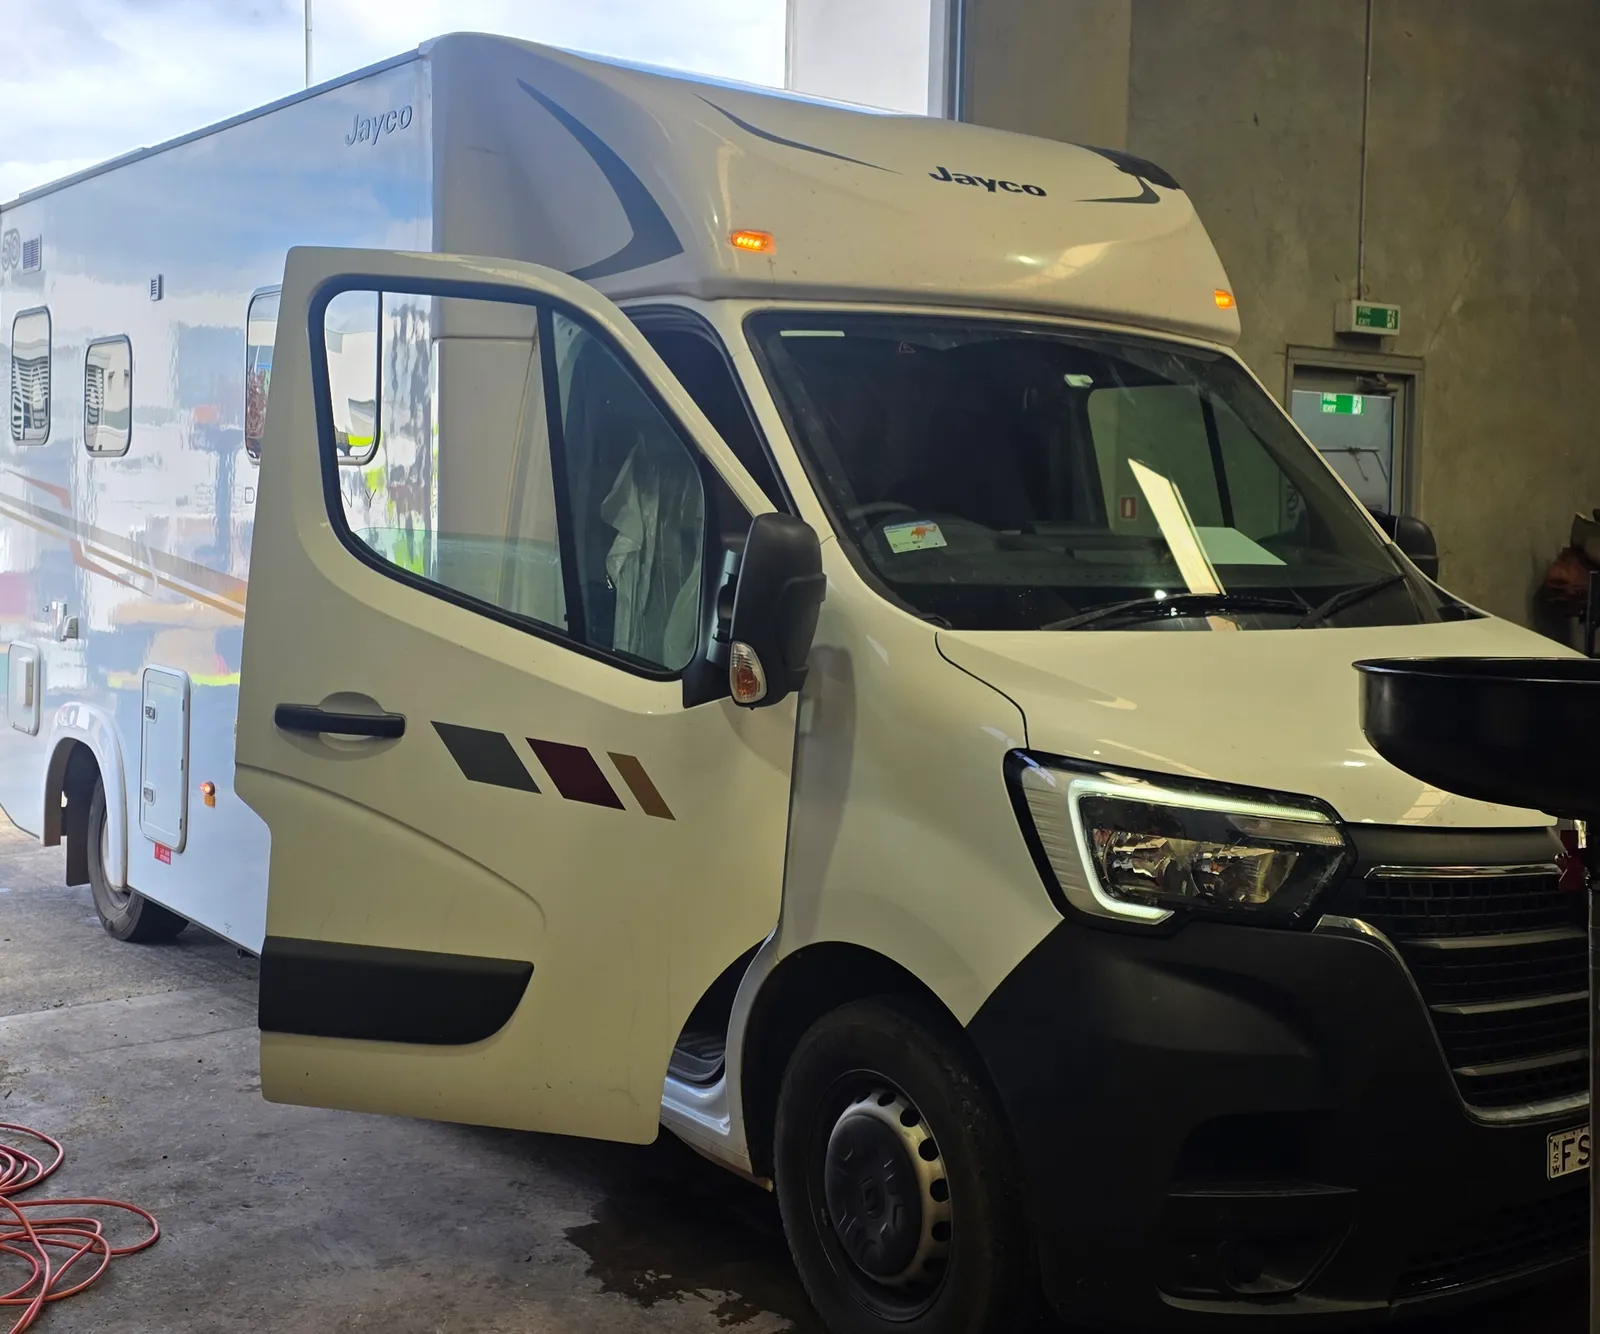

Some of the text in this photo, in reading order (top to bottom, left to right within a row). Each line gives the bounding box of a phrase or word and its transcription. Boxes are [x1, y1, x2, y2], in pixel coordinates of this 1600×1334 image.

[344, 105, 413, 147] Jayco
[928, 165, 1047, 197] Jayco
[1358, 306, 1371, 316] FIRE
[1358, 317, 1371, 327] EXIT
[1323, 392, 1337, 403] FIRE
[1322, 404, 1337, 413] EXIT
